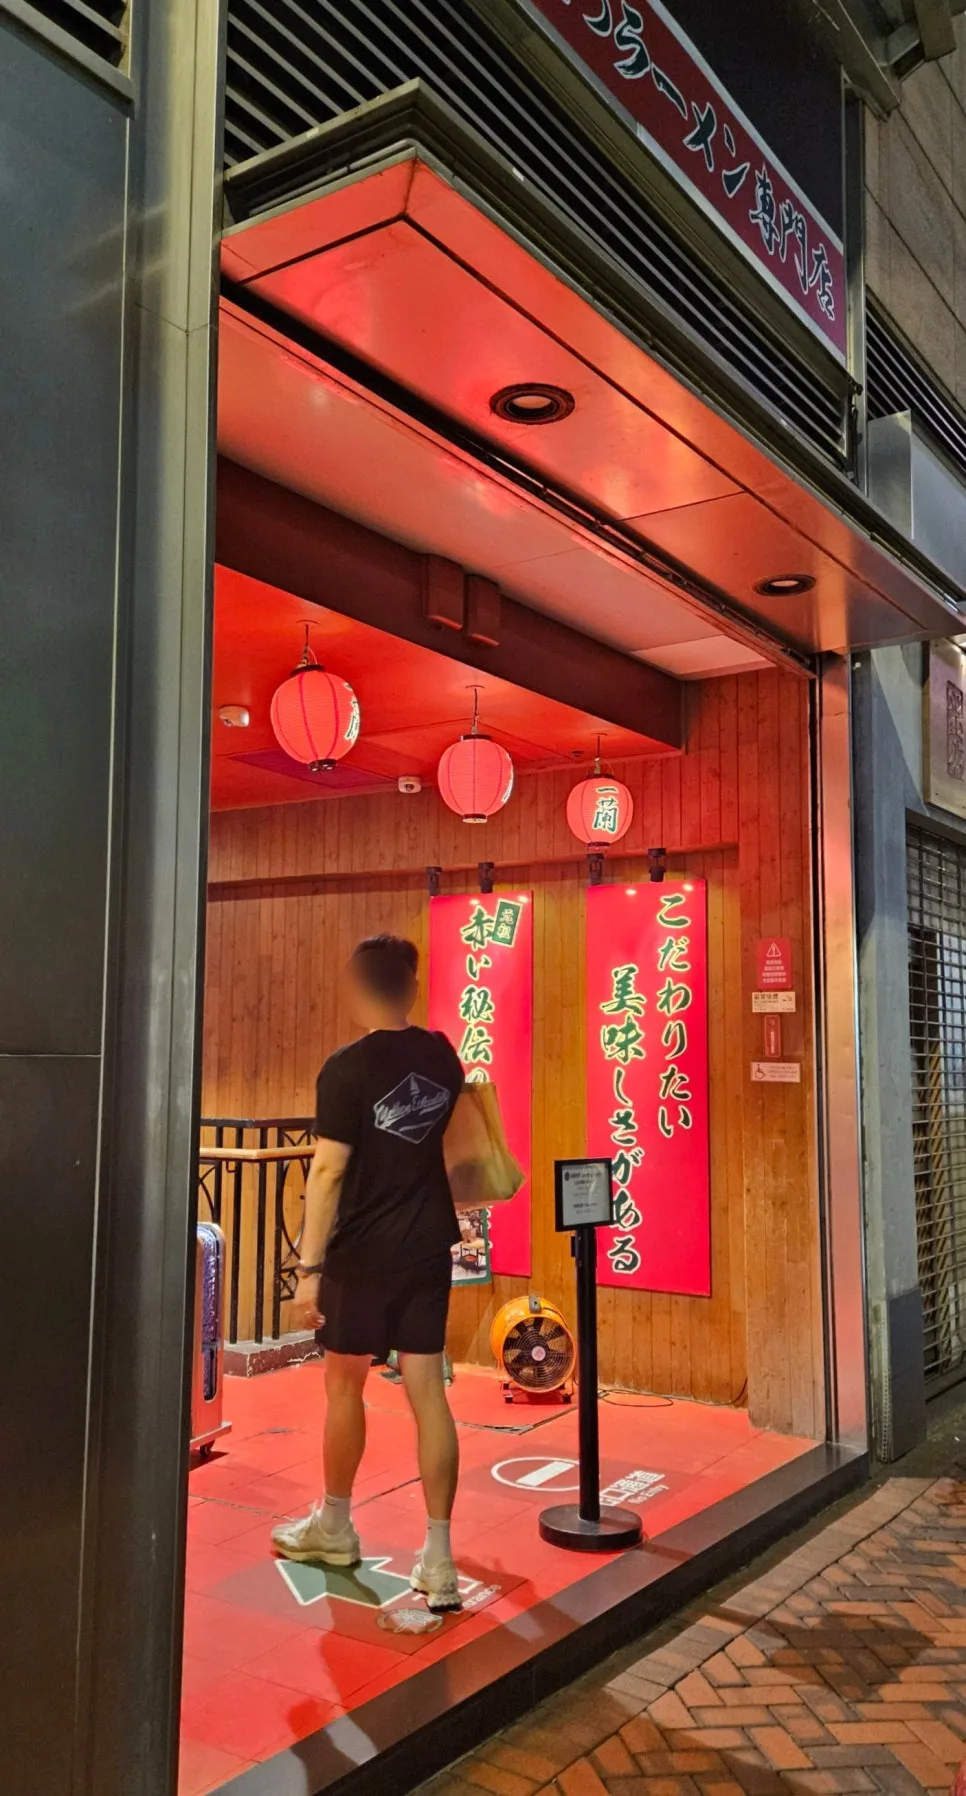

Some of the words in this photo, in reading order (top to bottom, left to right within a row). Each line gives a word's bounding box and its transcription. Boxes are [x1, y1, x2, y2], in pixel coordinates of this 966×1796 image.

[592, 786, 619, 834] 一蘭
[600, 964, 647, 1274] 美味しさがある
[656, 893, 692, 1138] こだわりたい
